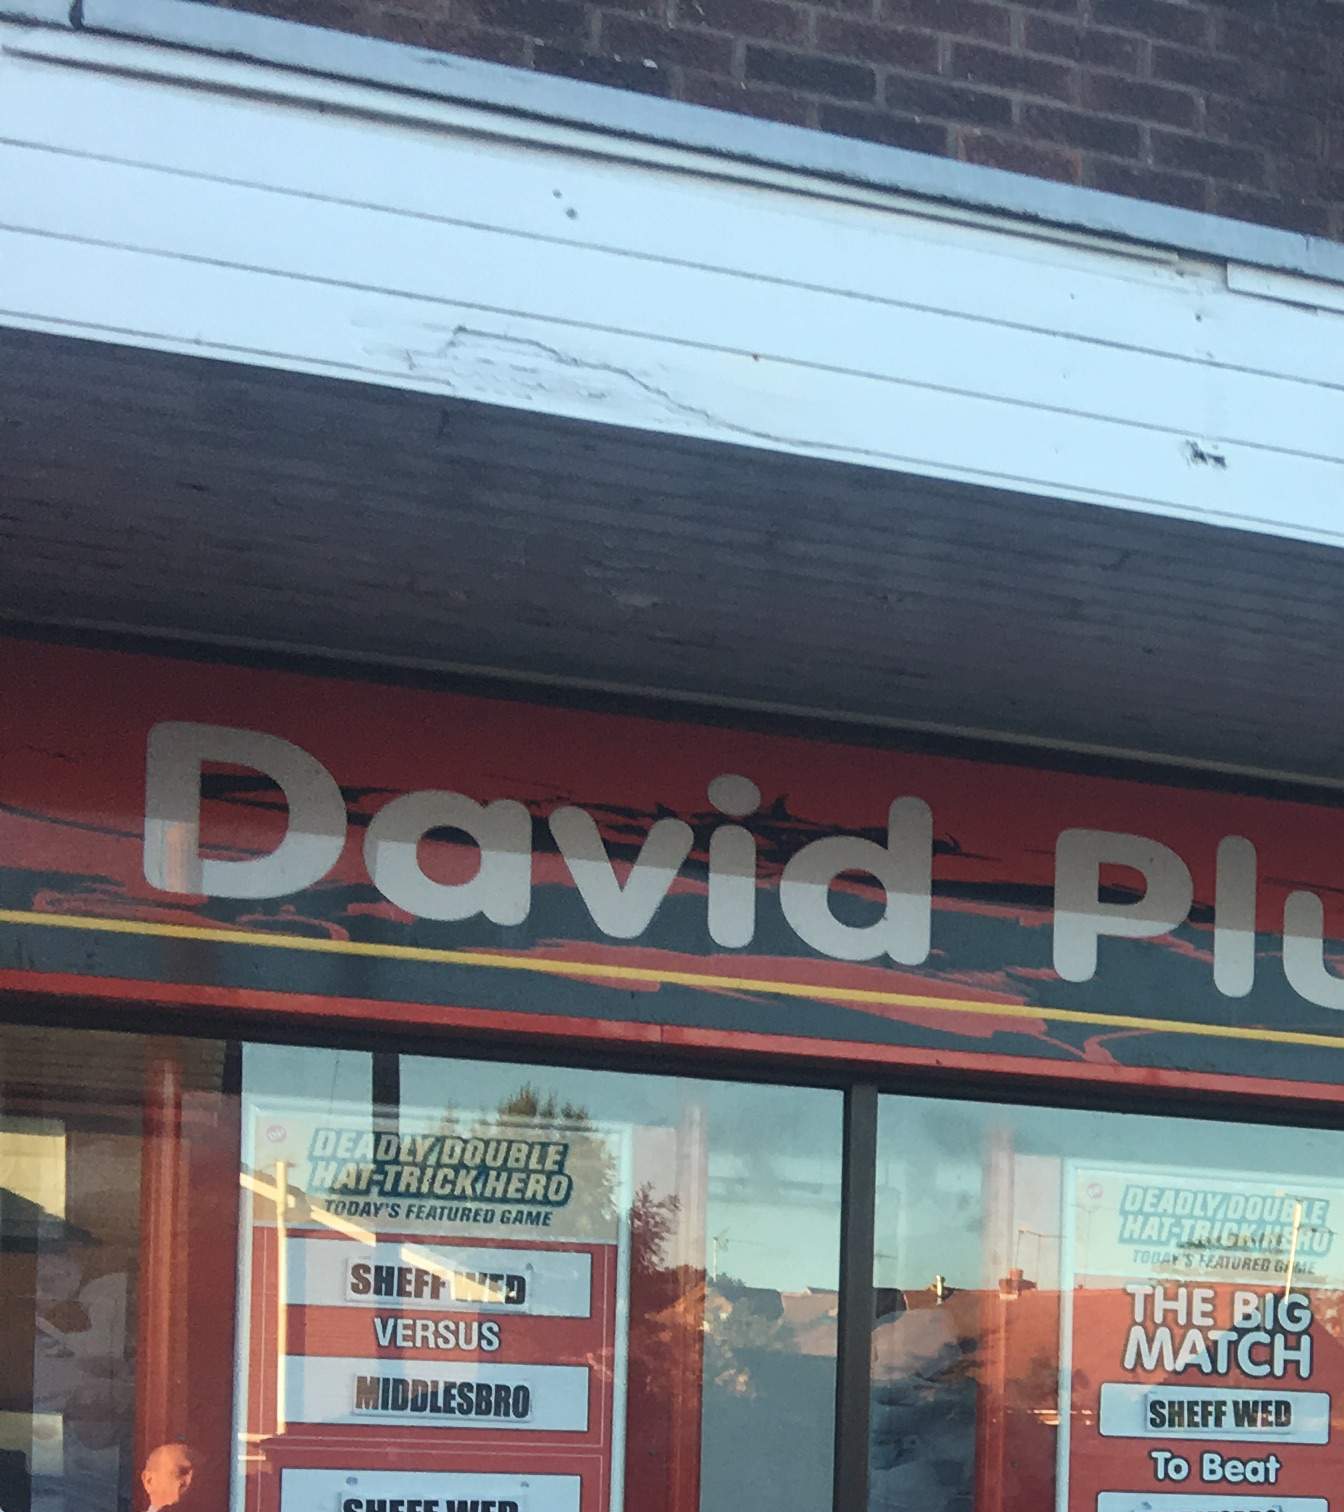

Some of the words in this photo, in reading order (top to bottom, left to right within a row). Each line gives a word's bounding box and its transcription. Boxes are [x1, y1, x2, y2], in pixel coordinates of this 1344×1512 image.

[143, 721, 934, 966] David
[310, 1129, 433, 1165] DEADLY
[440, 1139, 566, 1172] DOUBLE
[312, 1162, 478, 1197] HAT-TRICK
[480, 1173, 572, 1203] HERO
[324, 1199, 401, 1218] TODAY'S
[405, 1205, 496, 1225] FEATURED
[499, 1209, 553, 1227] GAME
[1124, 1186, 1221, 1219] DEADLY
[1224, 1195, 1328, 1225] DOUBLE
[1121, 1215, 1258, 1248] HAT-TRICK
[1133, 1250, 1193, 1268] TODAY'S
[1200, 1254, 1271, 1272] FEATURED
[350, 1263, 447, 1301] SHEFF
[1126, 1284, 1215, 1326] THE
[1232, 1291, 1312, 1333] BIG
[374, 1317, 501, 1352] VERSUS
[1123, 1326, 1312, 1378] MATCH
[355, 1375, 531, 1418] MIDDLESBRO
[1149, 1399, 1227, 1428] SHEFF
[1233, 1400, 1292, 1428] WED
[1151, 1451, 1189, 1481] To
[1202, 1453, 1281, 1484] Beat
